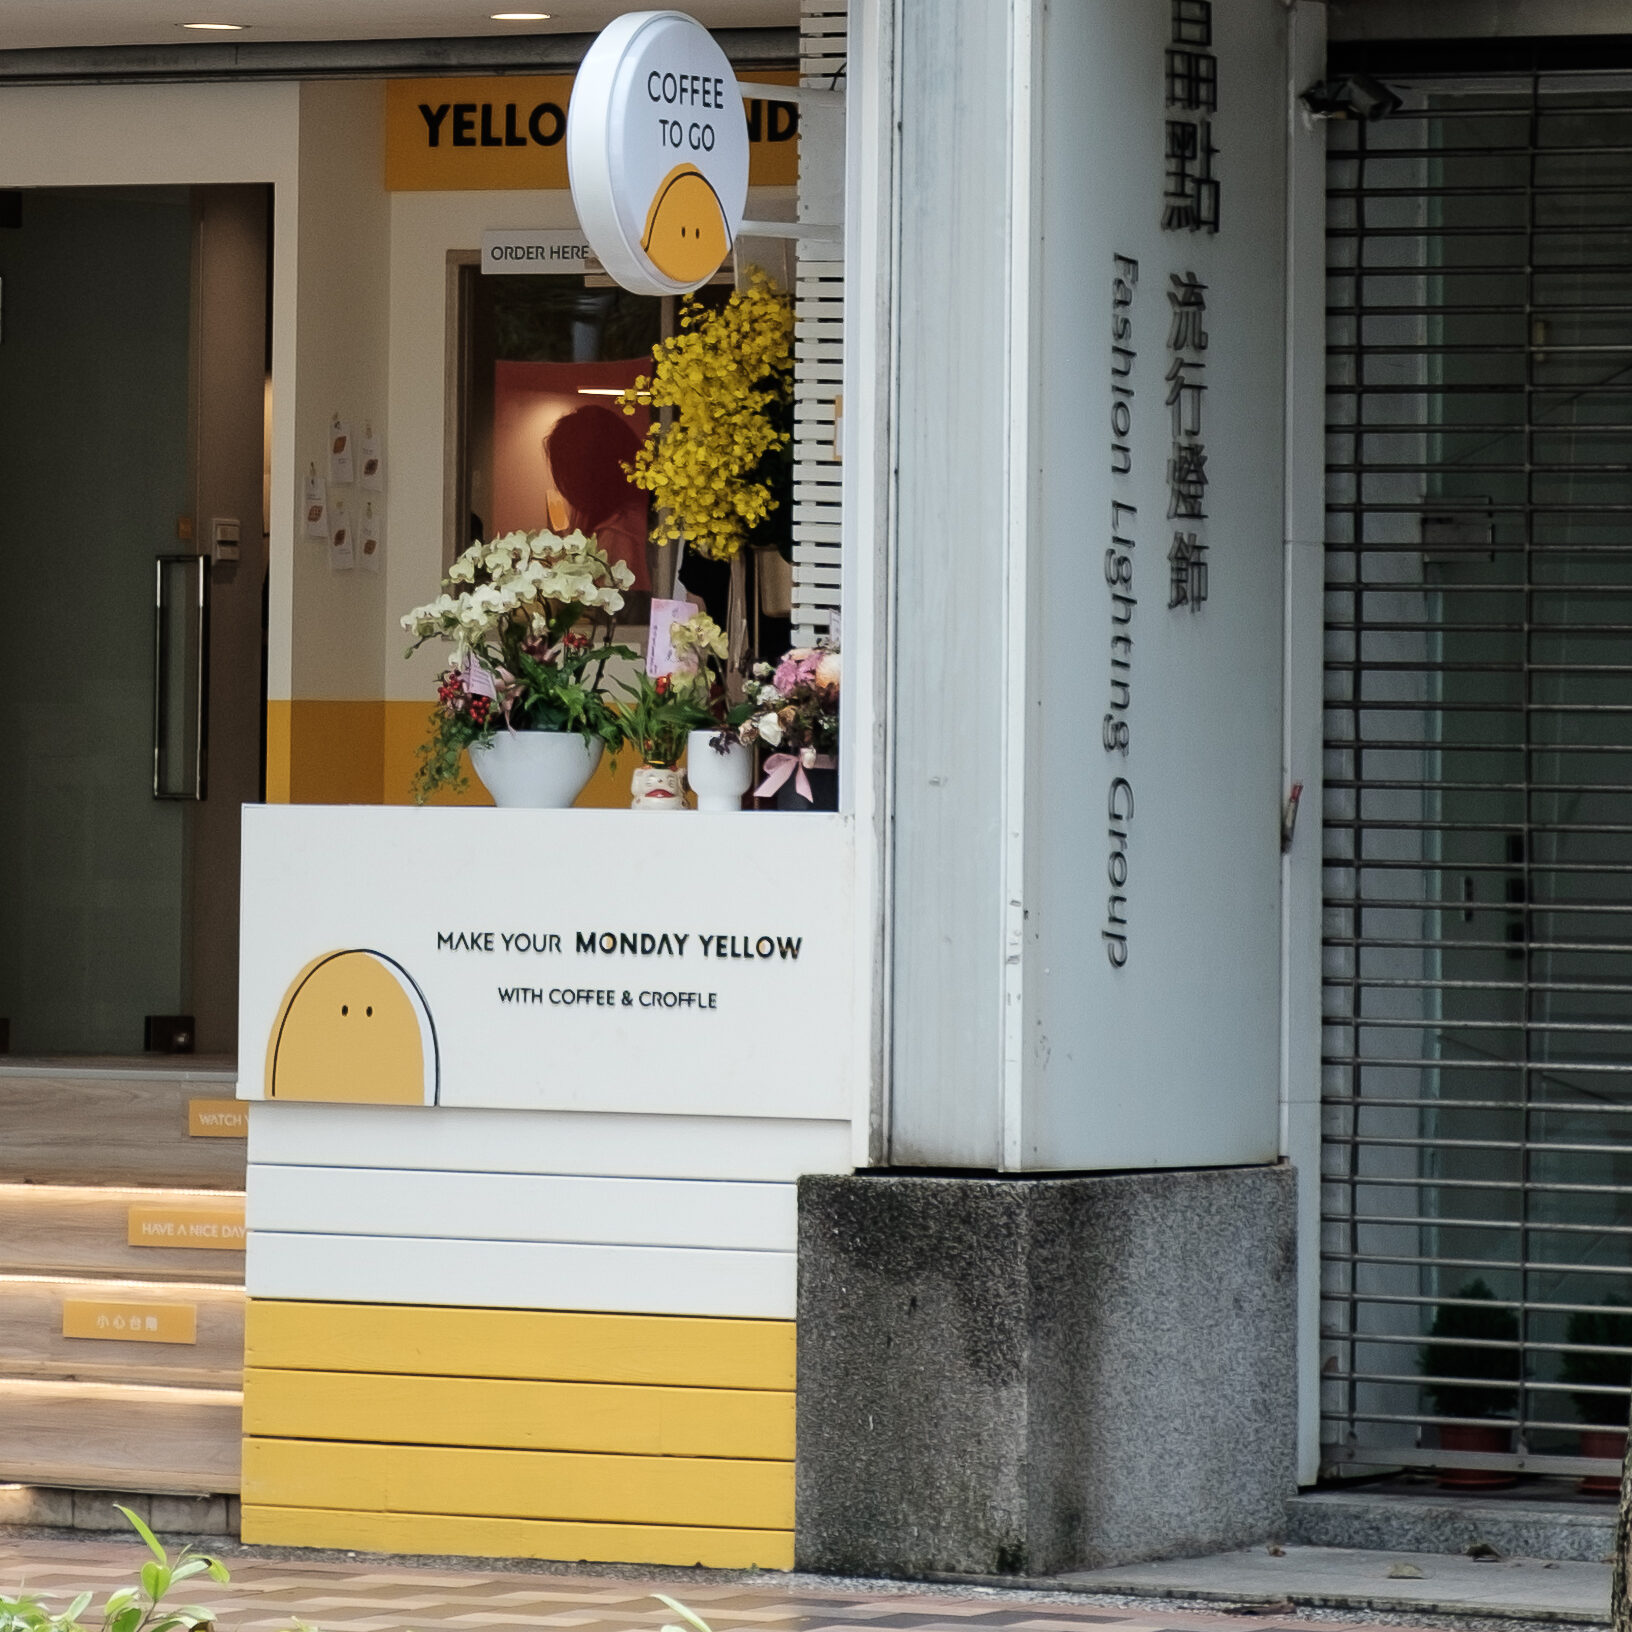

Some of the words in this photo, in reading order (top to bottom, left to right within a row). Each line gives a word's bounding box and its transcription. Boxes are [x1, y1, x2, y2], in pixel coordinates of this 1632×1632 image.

[647, 70, 725, 110] COFFEE
[659, 118, 683, 151] TO
[689, 122, 716, 153] GO
[491, 245, 545, 261] ORDER
[550, 245, 589, 260] HERE
[1111, 252, 1139, 475] Fashion
[1103, 499, 1138, 758] Lighting
[1102, 776, 1135, 969] Group
[437, 931, 495, 952] MAKE
[501, 933, 562, 953] YOUR
[576, 931, 690, 956] MONDAY
[699, 935, 803, 960] YELLOW
[498, 987, 543, 1004] WITH
[549, 988, 615, 1006] COFFEE
[621, 990, 633, 1006] &
[639, 991, 717, 1009] CROFFLE
[199, 1113, 242, 1126] WATCH
[142, 1223, 174, 1236] HAVE
[177, 1224, 187, 1236] A
[189, 1224, 218, 1237] NICE
